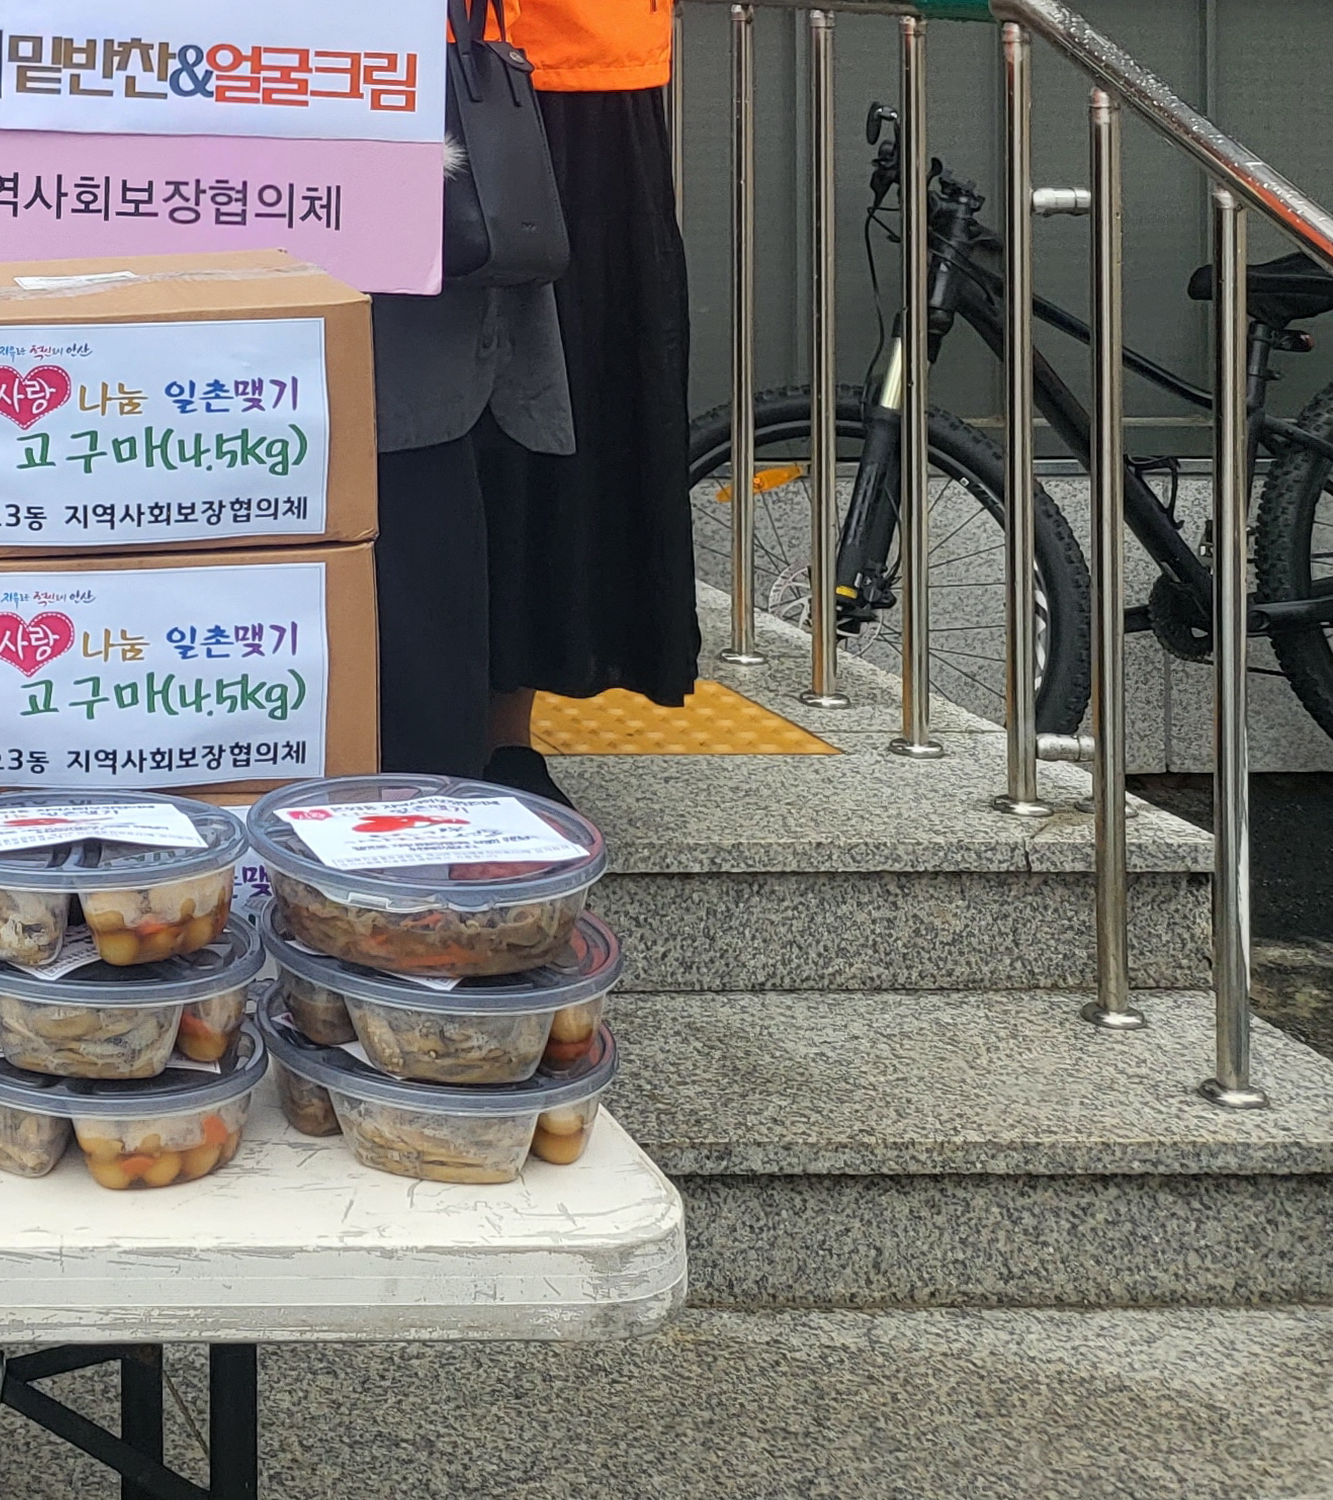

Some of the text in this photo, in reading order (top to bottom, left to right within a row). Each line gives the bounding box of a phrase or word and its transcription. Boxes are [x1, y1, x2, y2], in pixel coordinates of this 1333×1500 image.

[79, 382, 149, 416] 나눔
[165, 377, 298, 414] 일촌맺기
[17, 425, 308, 476] 고구마(4.5kg)
[65, 496, 307, 529] 지역사회보장협의체
[82, 629, 151, 662] 나눔
[167, 621, 298, 659] 일촌맺기
[20, 669, 306, 721] 고구마(4.5kg)
[67, 740, 306, 775] 지역사회보장협의체
